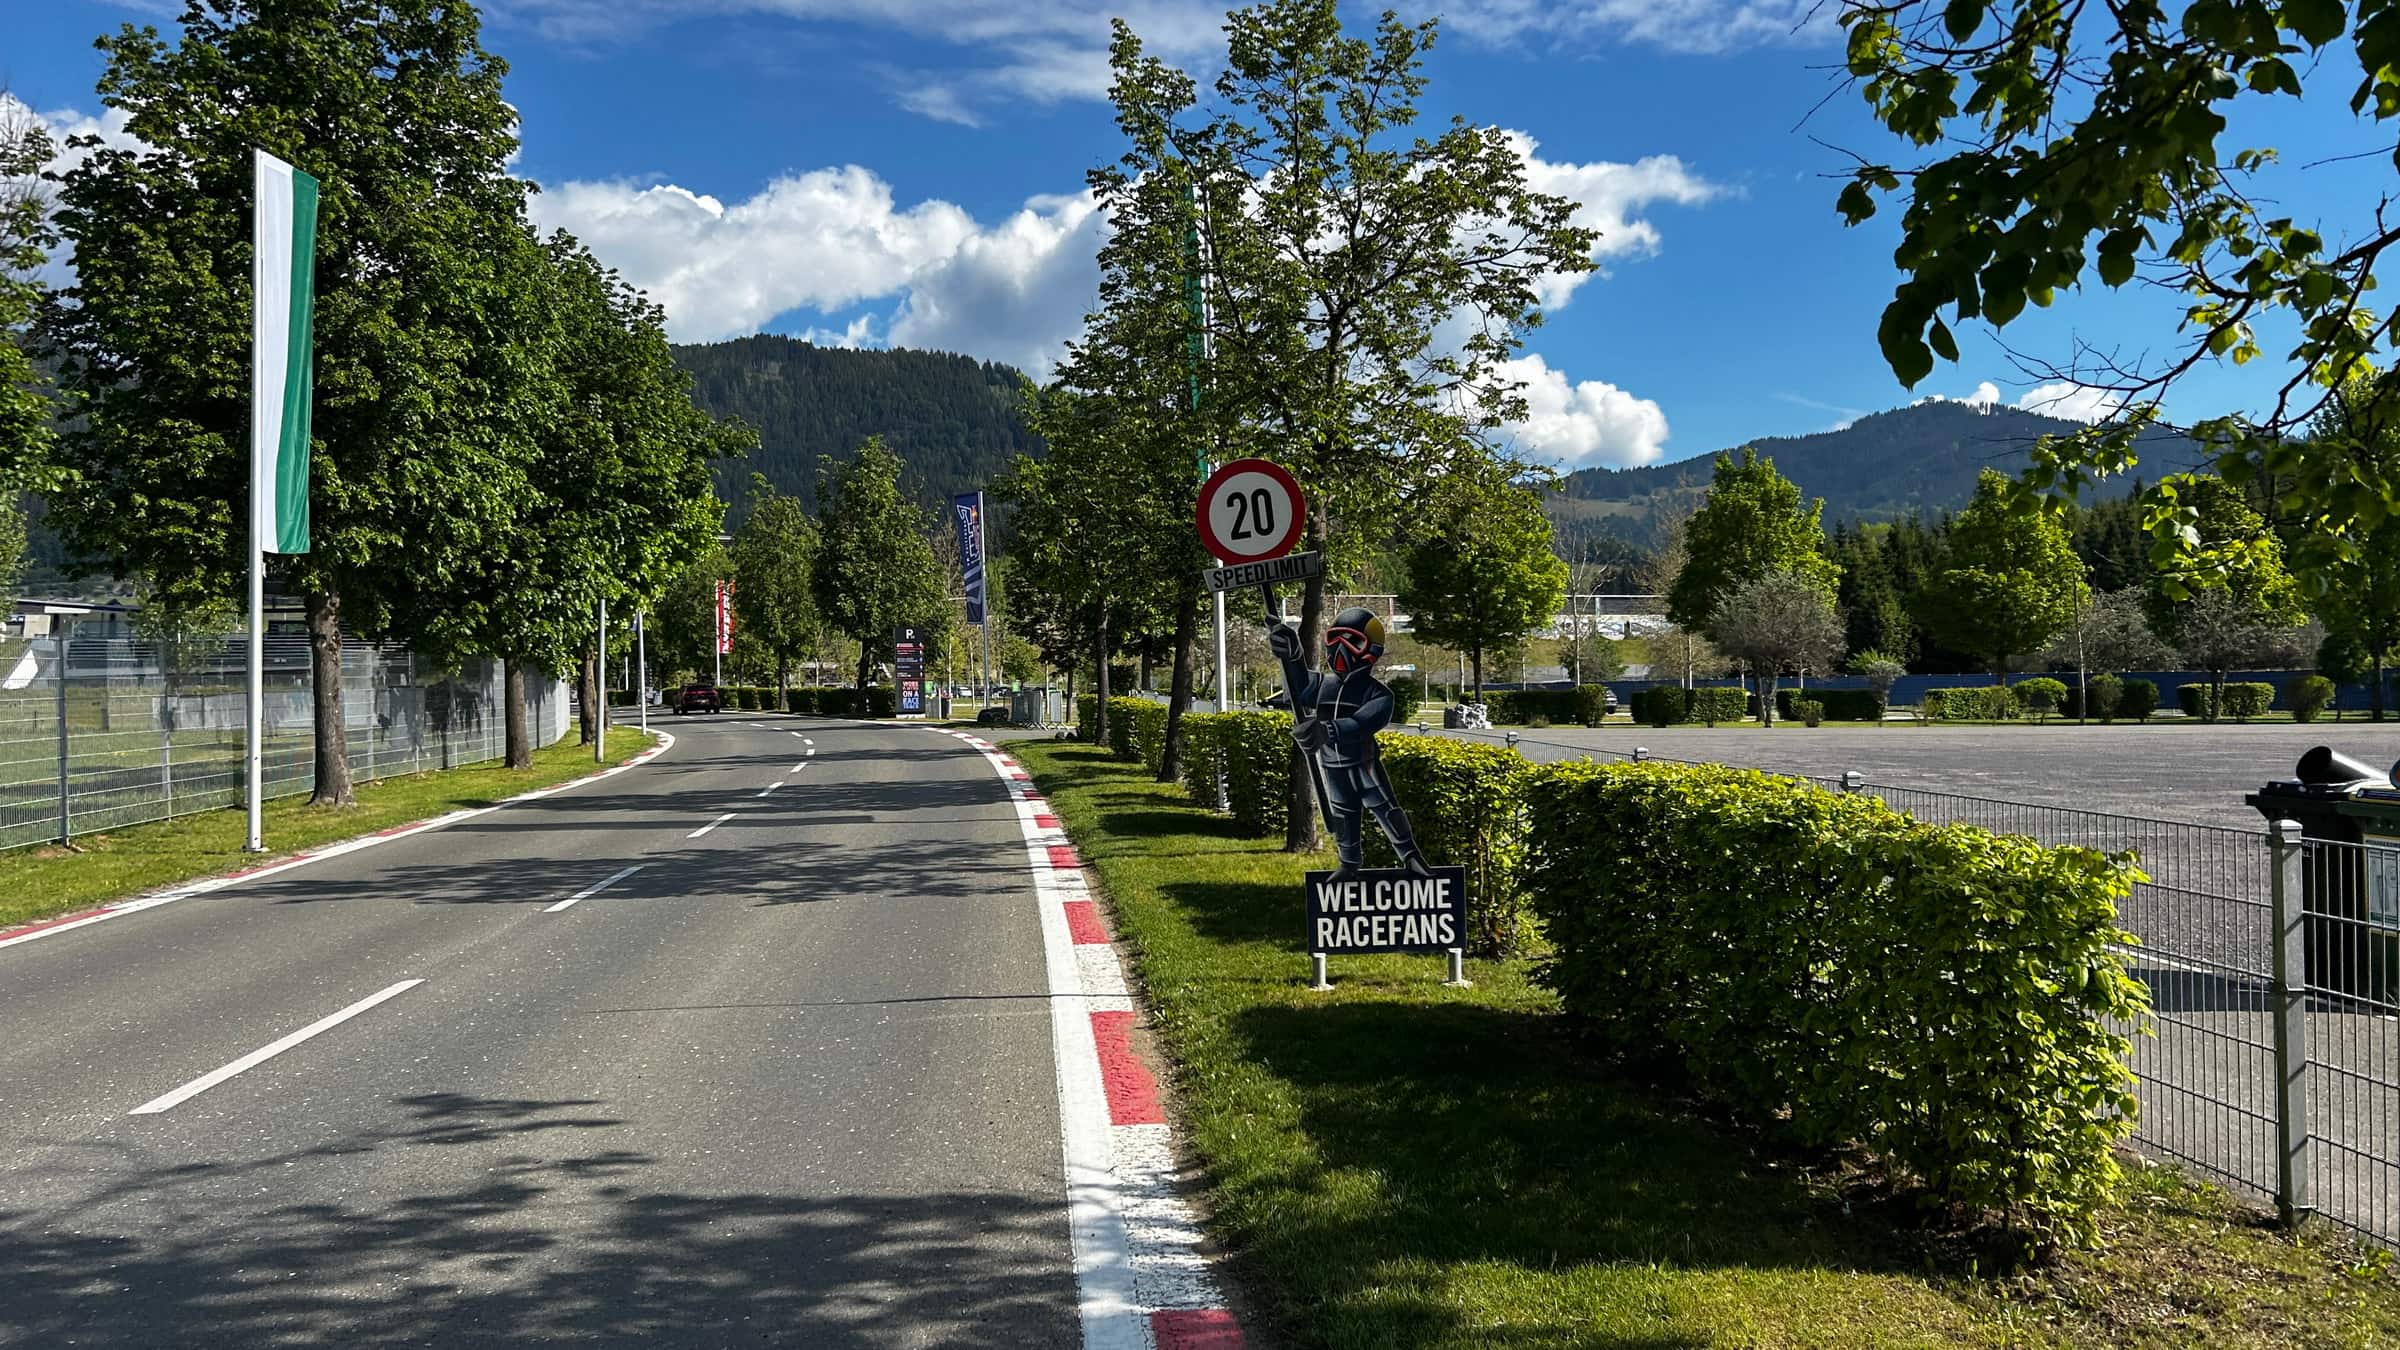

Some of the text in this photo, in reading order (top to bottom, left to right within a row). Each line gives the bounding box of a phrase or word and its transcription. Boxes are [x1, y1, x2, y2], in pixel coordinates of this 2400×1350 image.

[1226, 488, 1275, 541] 20
[1212, 556, 1308, 589] SPEEDLIMIT
[1316, 878, 1452, 913] WELCOME
[1317, 913, 1456, 948] RACEFANS
